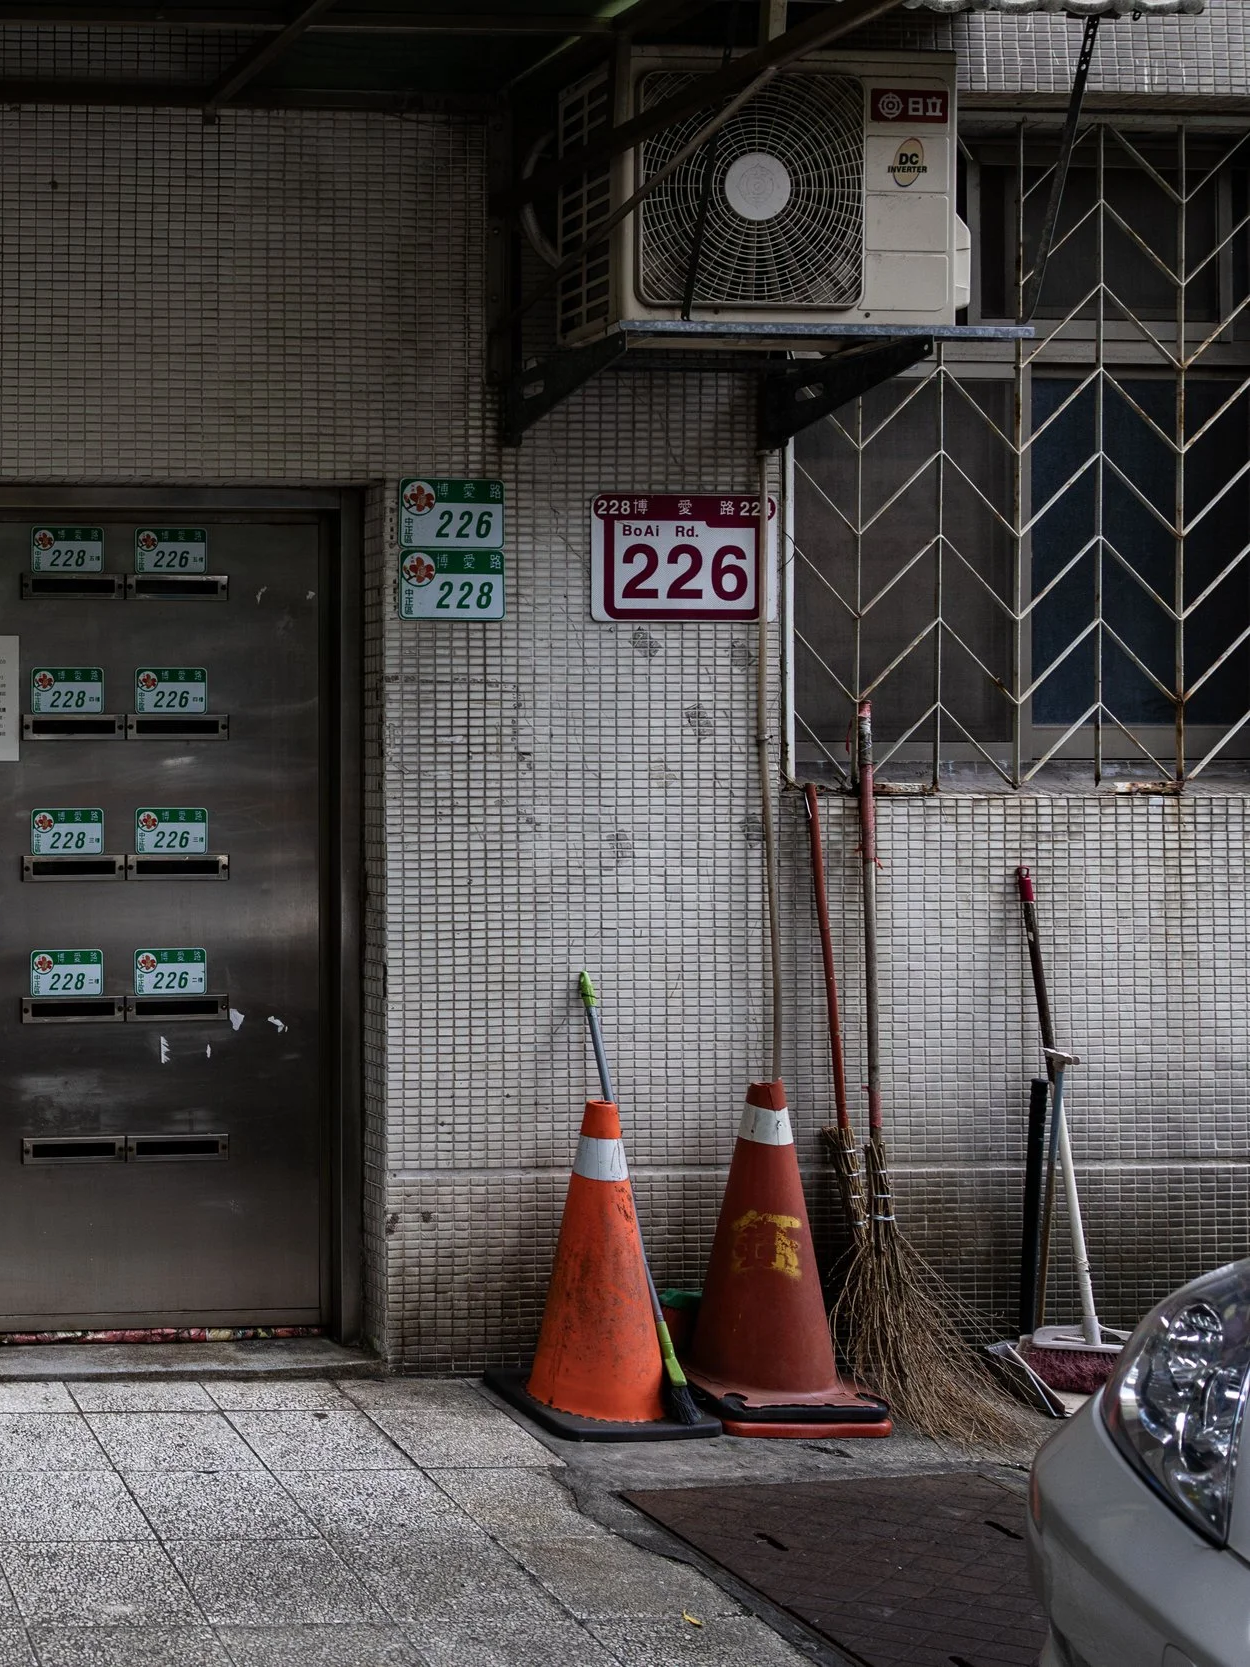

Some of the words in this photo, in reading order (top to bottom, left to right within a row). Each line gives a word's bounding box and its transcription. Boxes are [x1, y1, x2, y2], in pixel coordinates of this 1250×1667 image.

[908, 96, 942, 116] 日立
[899, 153, 919, 165] DC
[437, 482, 501, 499] 博愛路
[597, 499, 631, 515] 228
[633, 498, 735, 516] 博愛路
[404, 517, 414, 544] 中正區
[435, 510, 493, 538] 226
[622, 525, 660, 537] BoAi
[675, 525, 699, 538] Rd.
[50, 549, 86, 567] 228
[153, 550, 190, 568] 226
[437, 553, 501, 569] 博愛路
[622, 543, 748, 601] 226
[404, 588, 414, 615] 中正區
[436, 581, 494, 609] 228
[50, 690, 86, 708] 228
[153, 690, 190, 708] 226
[50, 831, 86, 849] 228
[154, 830, 190, 848] 226
[49, 972, 86, 991] 228
[153, 971, 189, 989] 226
